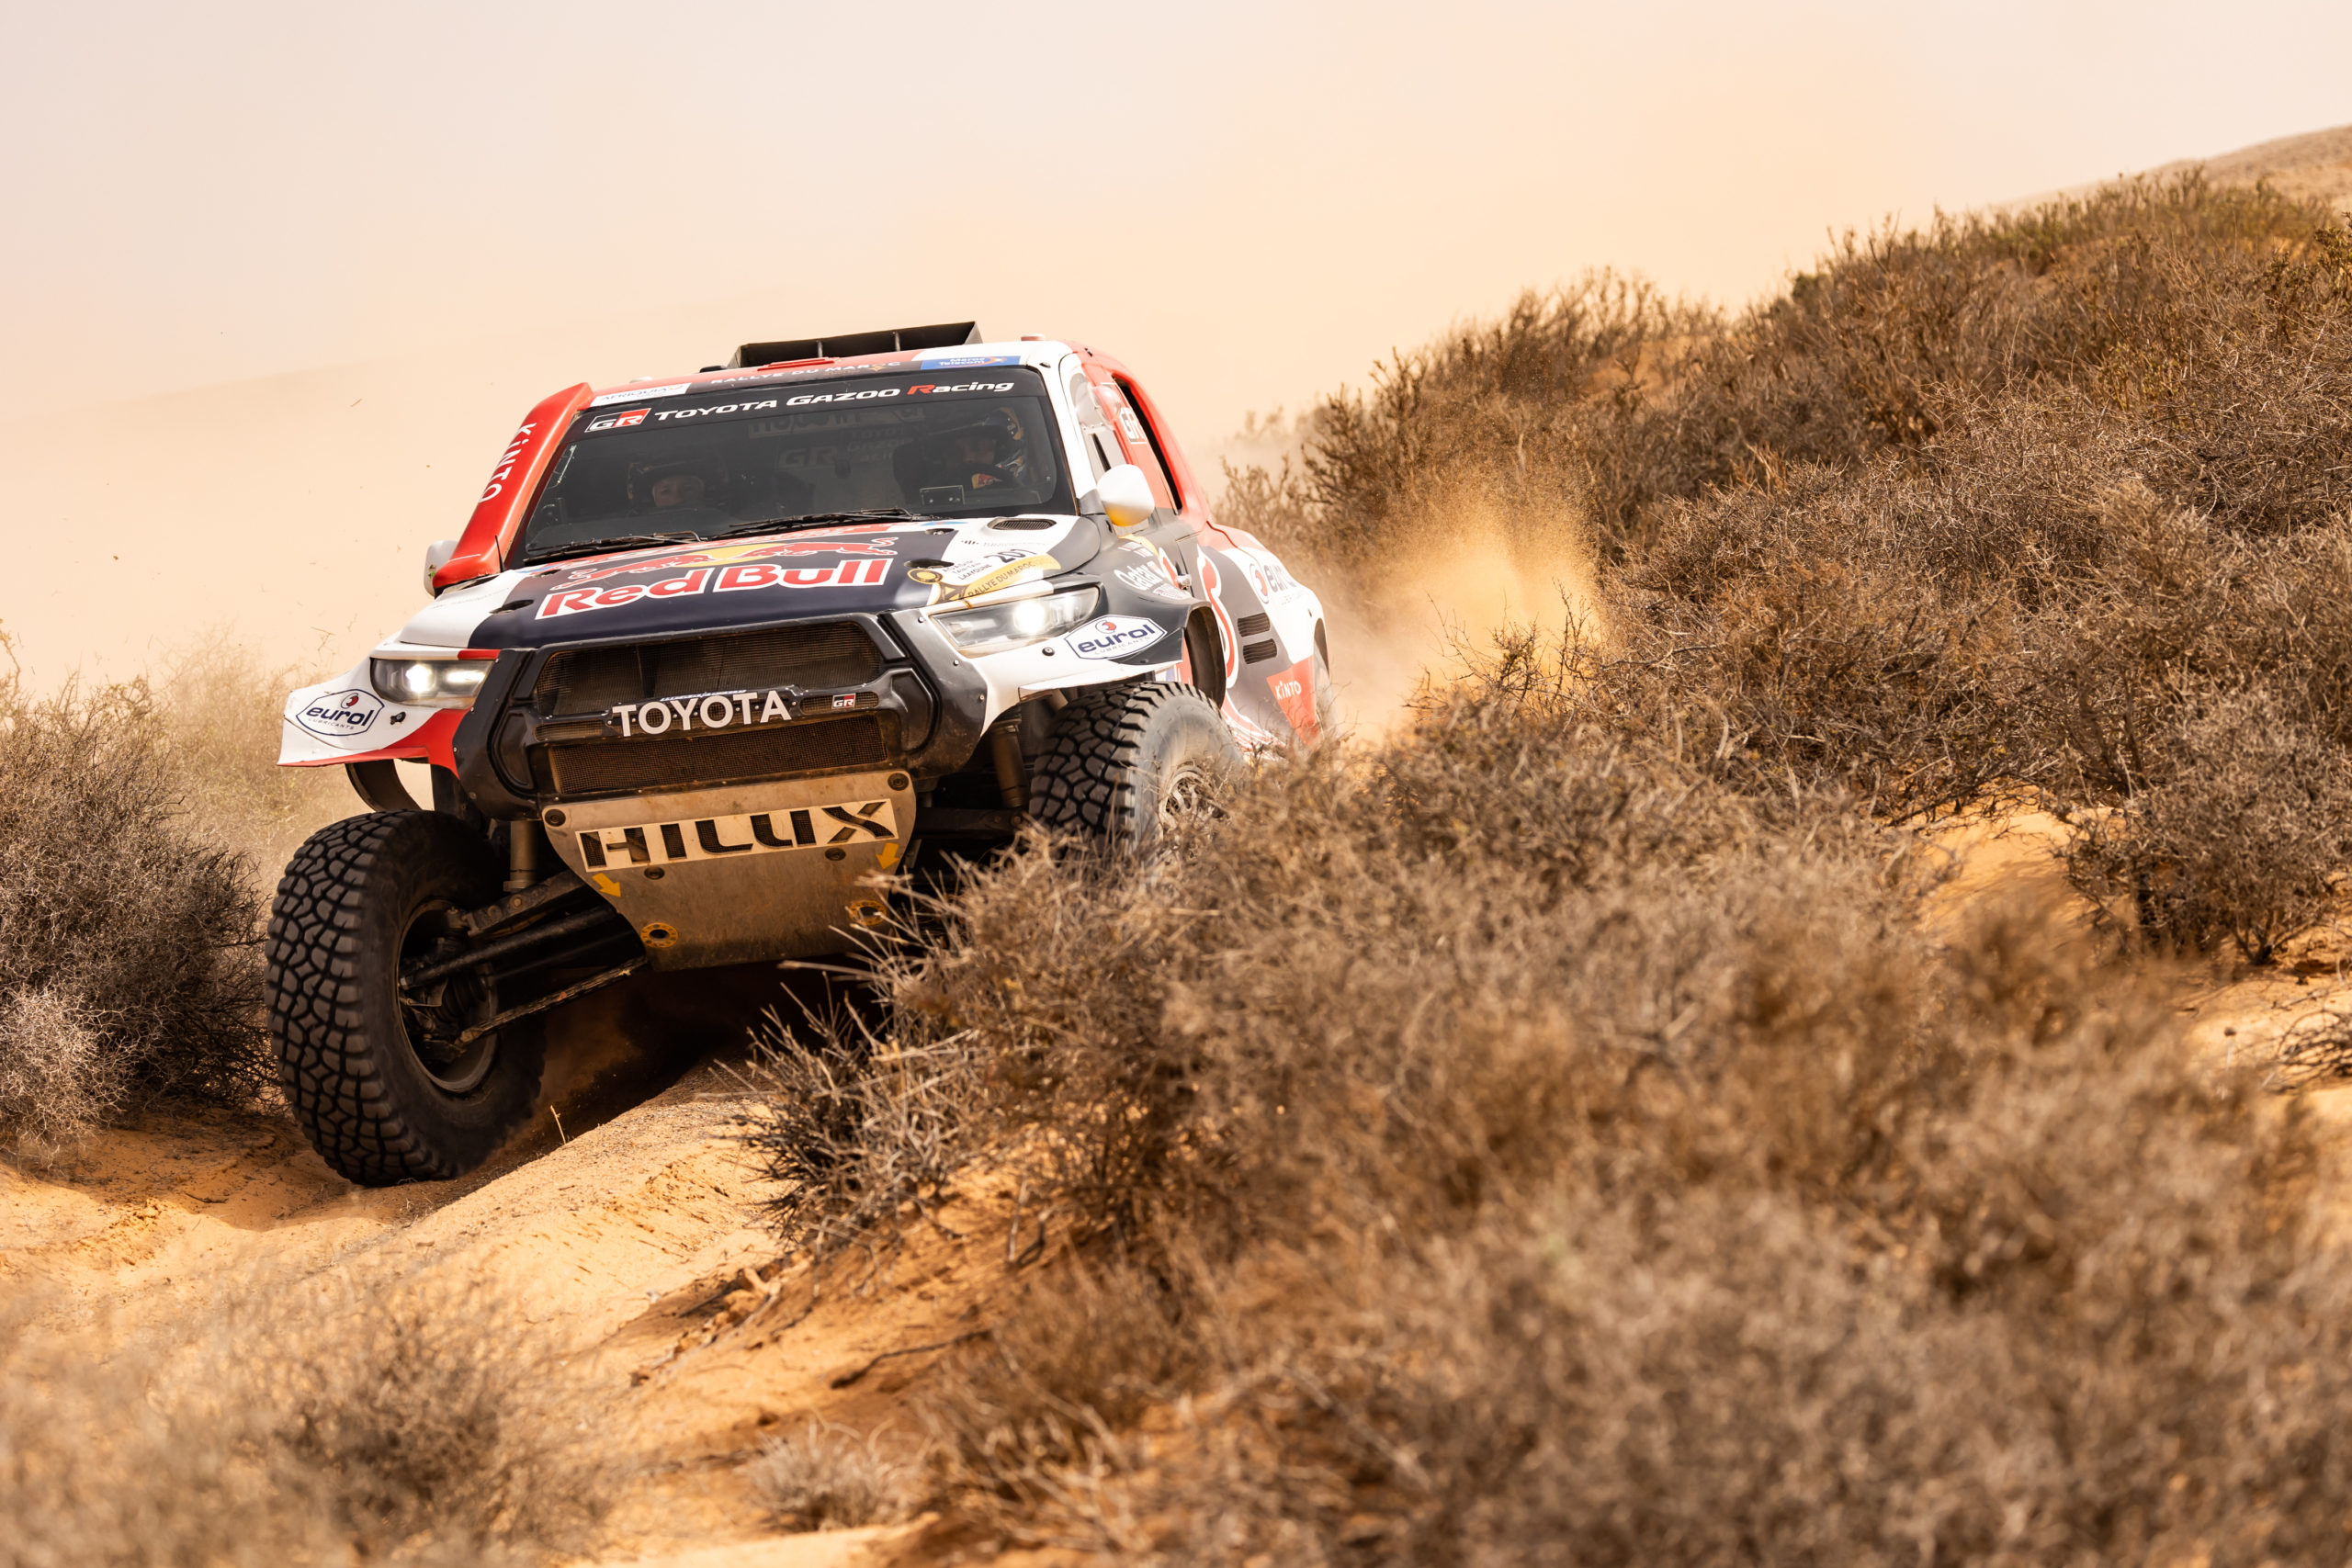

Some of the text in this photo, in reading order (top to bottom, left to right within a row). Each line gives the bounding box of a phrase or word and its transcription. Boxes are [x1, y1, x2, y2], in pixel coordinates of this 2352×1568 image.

[710, 372, 784, 384] RALLYE
[589, 381, 1015, 431] GR TOYOTA GAZOO Racing
[983, 548, 1037, 563] 201
[535, 568, 713, 620] Red
[713, 558, 894, 592] Bull
[995, 571, 1010, 583] DU
[1078, 625, 1155, 653] eurol
[306, 707, 374, 726] eurol
[613, 690, 792, 738] TOYOTA
[833, 697, 855, 707] GR
[580, 801, 895, 868] HILUX
